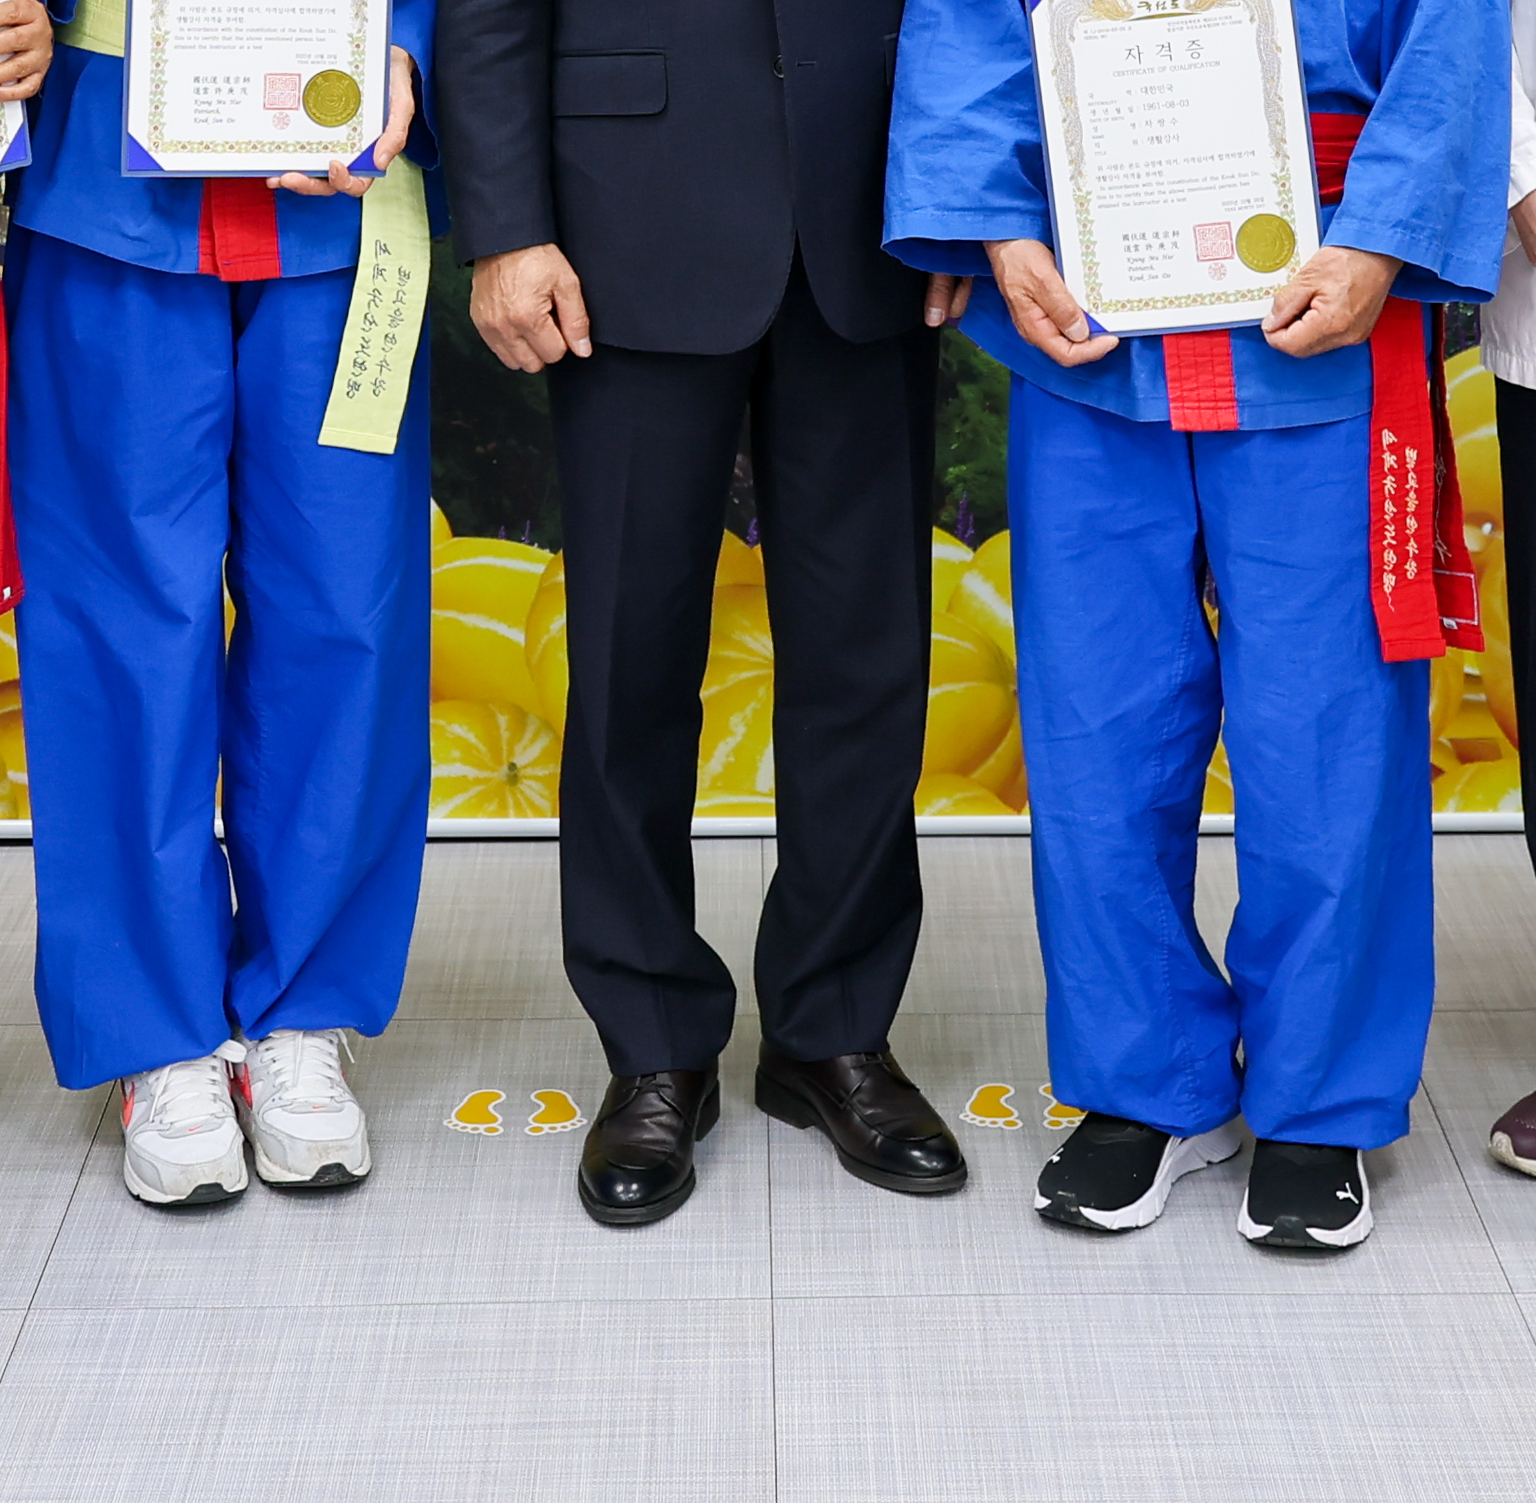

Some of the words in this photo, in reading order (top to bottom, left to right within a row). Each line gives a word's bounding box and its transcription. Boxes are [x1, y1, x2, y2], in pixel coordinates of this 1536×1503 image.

[1112, 67, 1155, 77] CERTIFICATE
[1169, 59, 1220, 71] QUALIFICATION
[1140, 83, 1173, 95] 대한민국
[1142, 98, 1189, 111] 1961-08-03
